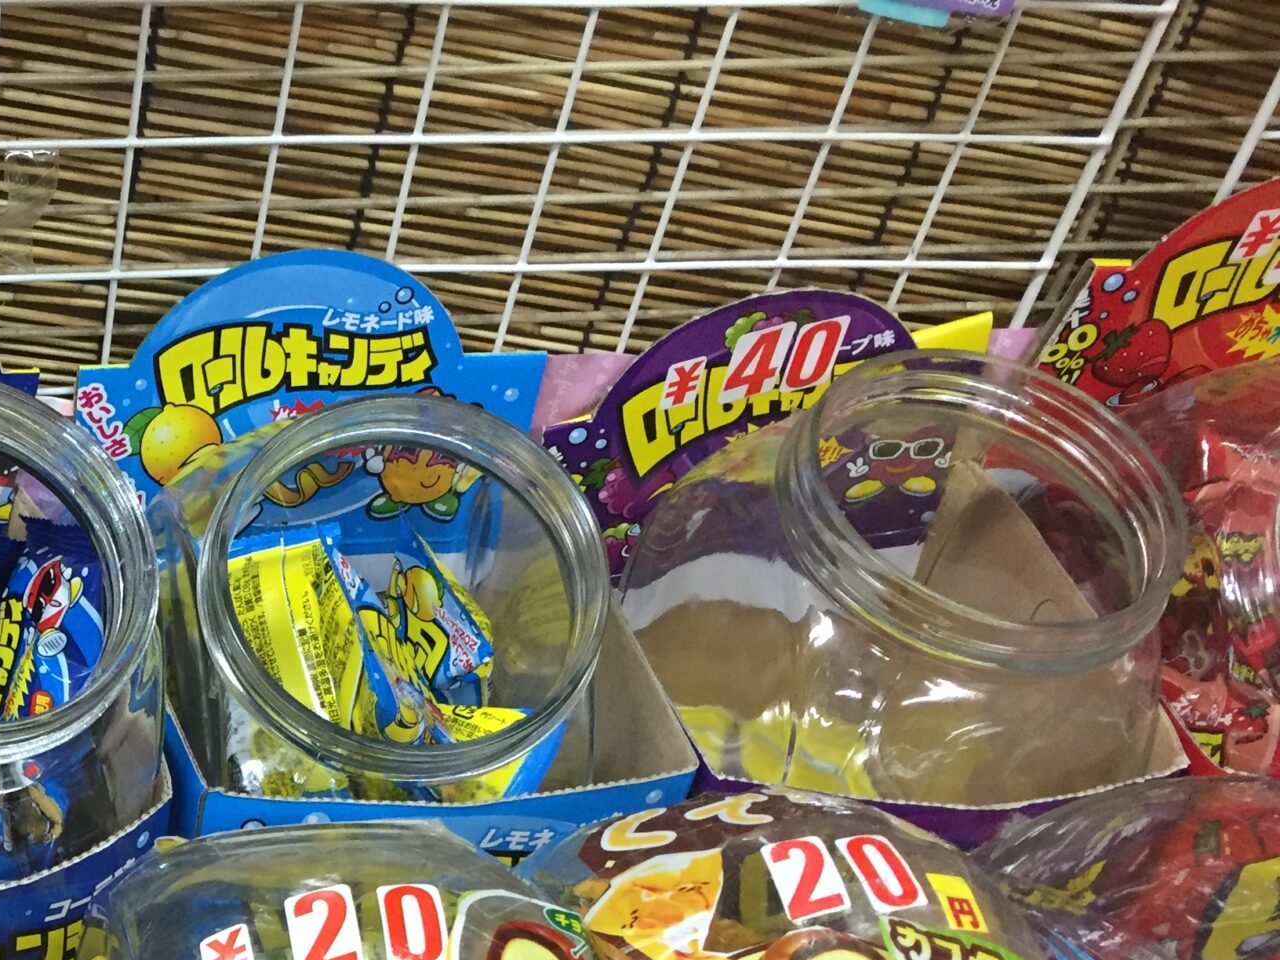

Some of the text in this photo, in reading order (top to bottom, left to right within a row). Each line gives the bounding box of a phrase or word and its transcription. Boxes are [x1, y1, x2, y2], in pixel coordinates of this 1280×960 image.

[322, 306, 435, 333] レモネード味
[159, 326, 435, 413] ロールキャンディ
[666, 321, 842, 406] ¥40
[79, 387, 129, 458] おいしさ
